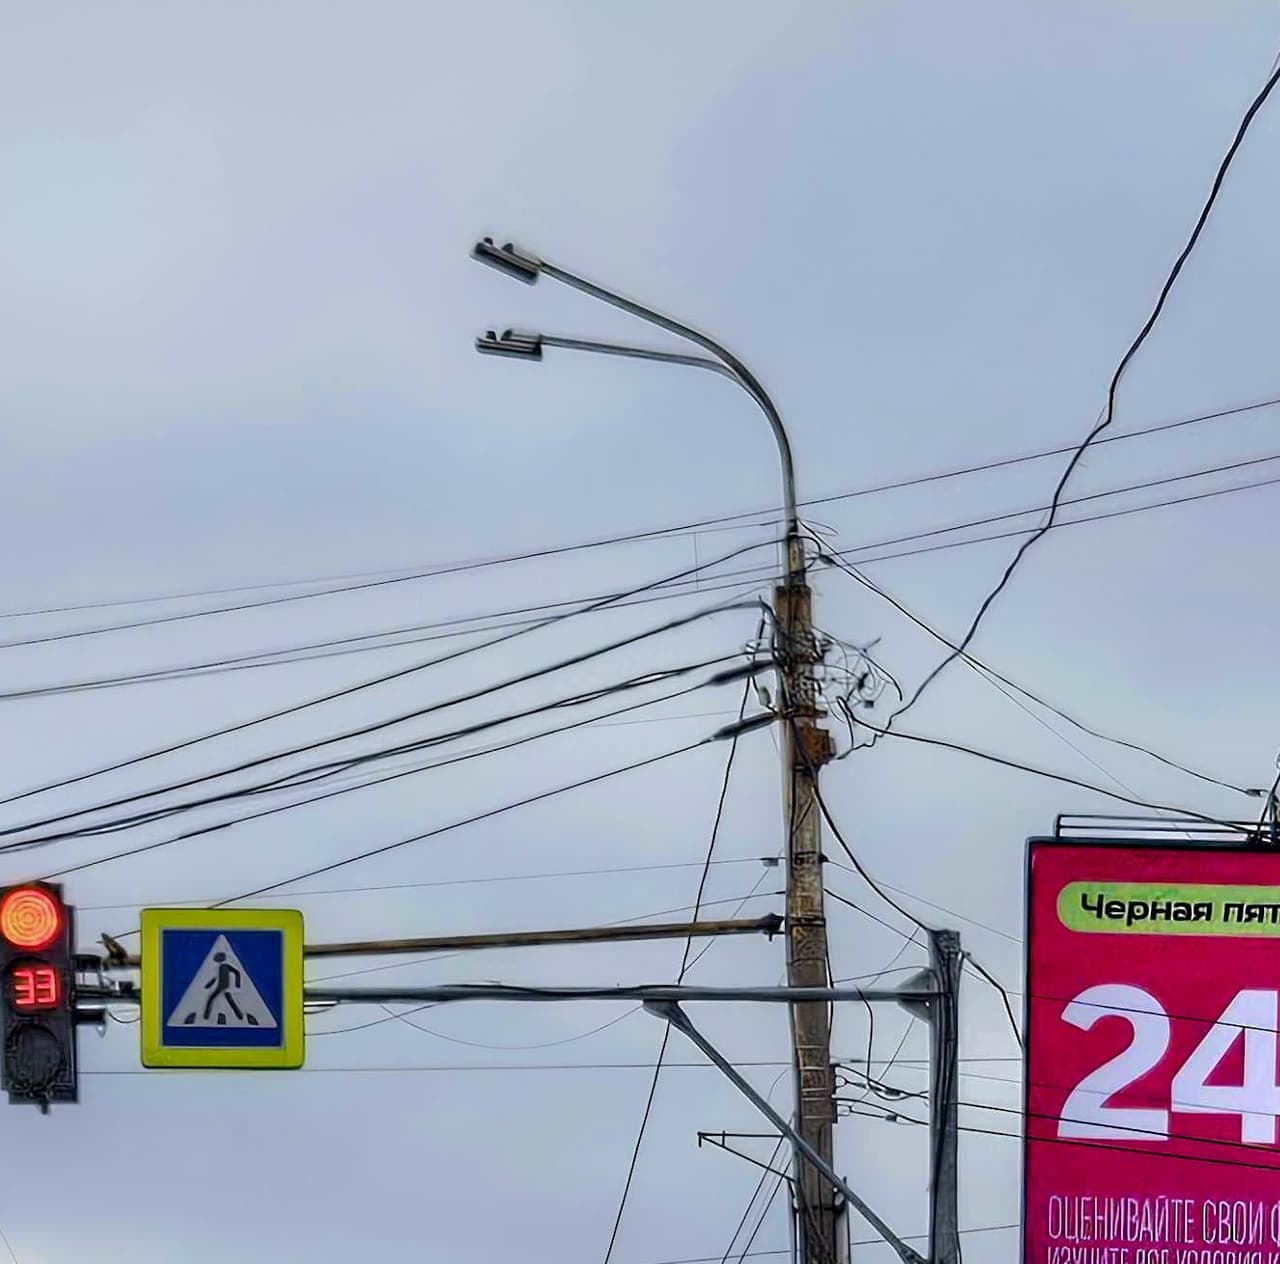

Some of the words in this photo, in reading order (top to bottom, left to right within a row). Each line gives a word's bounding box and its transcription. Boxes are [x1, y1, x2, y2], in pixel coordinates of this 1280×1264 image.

[1081, 893, 1212, 927] Черная
[14, 969, 56, 1004] 33
[1048, 1195, 1194, 1244] ОЦЕНИВАЙТЕ
[1202, 1200, 1263, 1245] СВОИ
